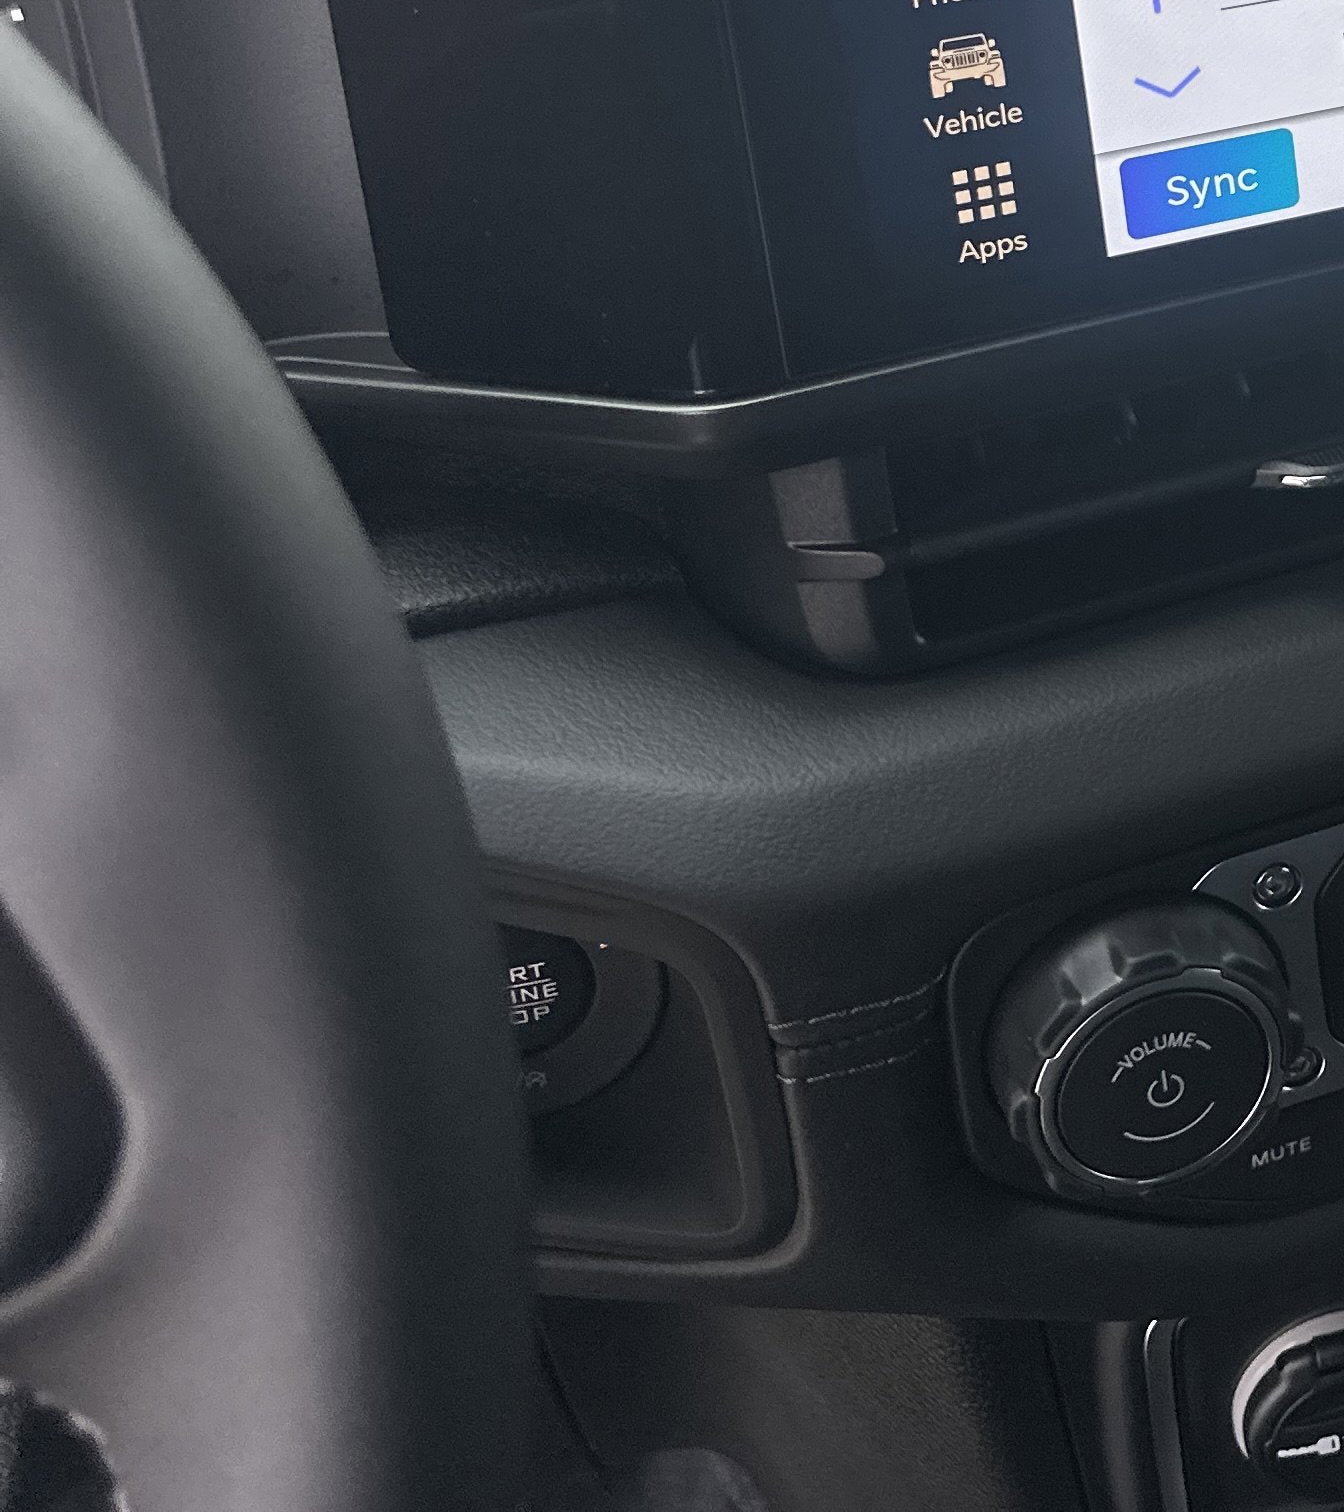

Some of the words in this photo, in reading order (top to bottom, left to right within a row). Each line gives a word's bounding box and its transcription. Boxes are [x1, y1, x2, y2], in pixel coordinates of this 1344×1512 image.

[923, 102, 1024, 138] Vehicle
[1166, 166, 1260, 209] Sync
[958, 232, 1030, 265] Apps
[510, 982, 559, 1003] INE
[1117, 1031, 1197, 1073] VOLUME
[1250, 1136, 1312, 1168] MUTE
